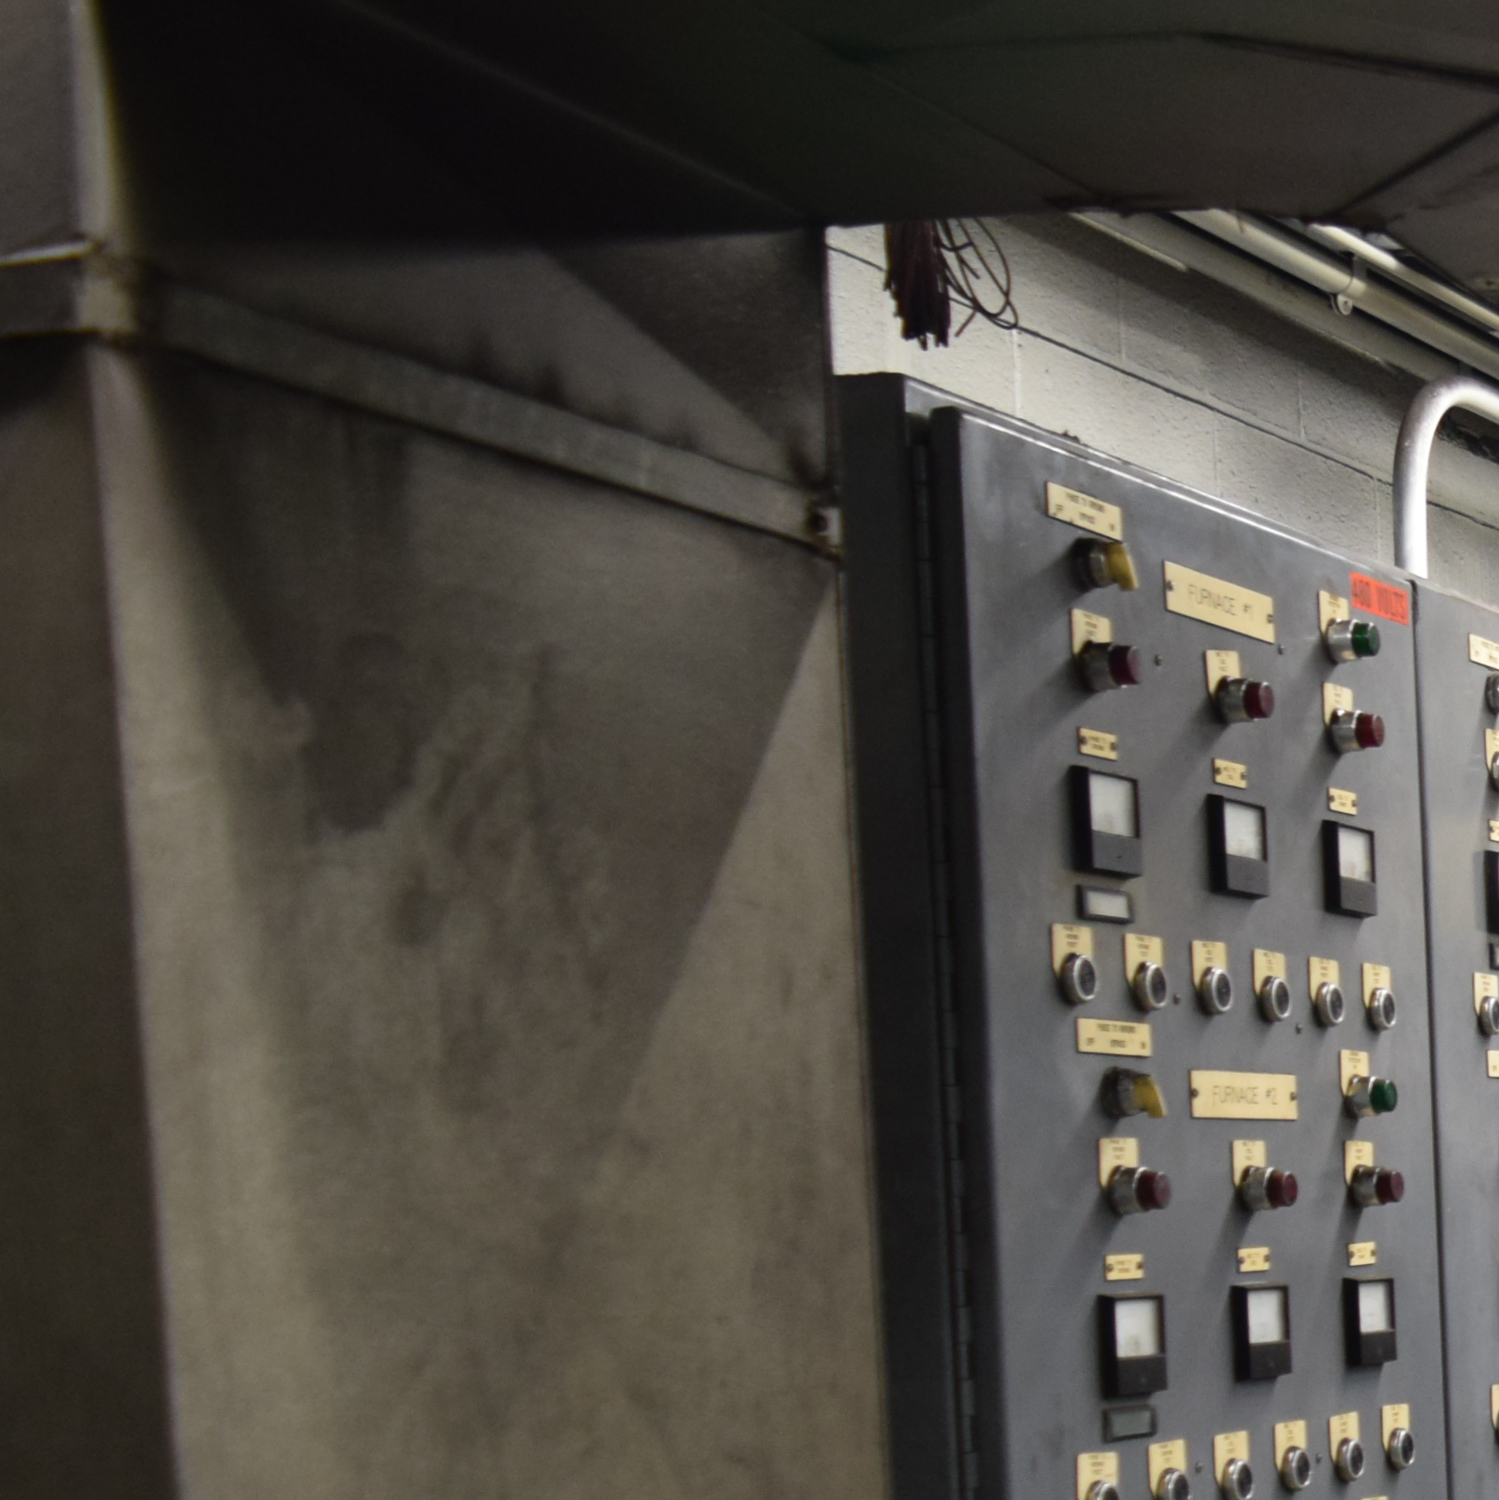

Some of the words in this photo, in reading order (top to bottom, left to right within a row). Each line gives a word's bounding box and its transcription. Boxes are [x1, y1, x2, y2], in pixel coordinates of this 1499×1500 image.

[1188, 583, 1236, 616] FURNACE
[1211, 1084, 1259, 1105] FURNACE
[1265, 1087, 1278, 1106] #2
